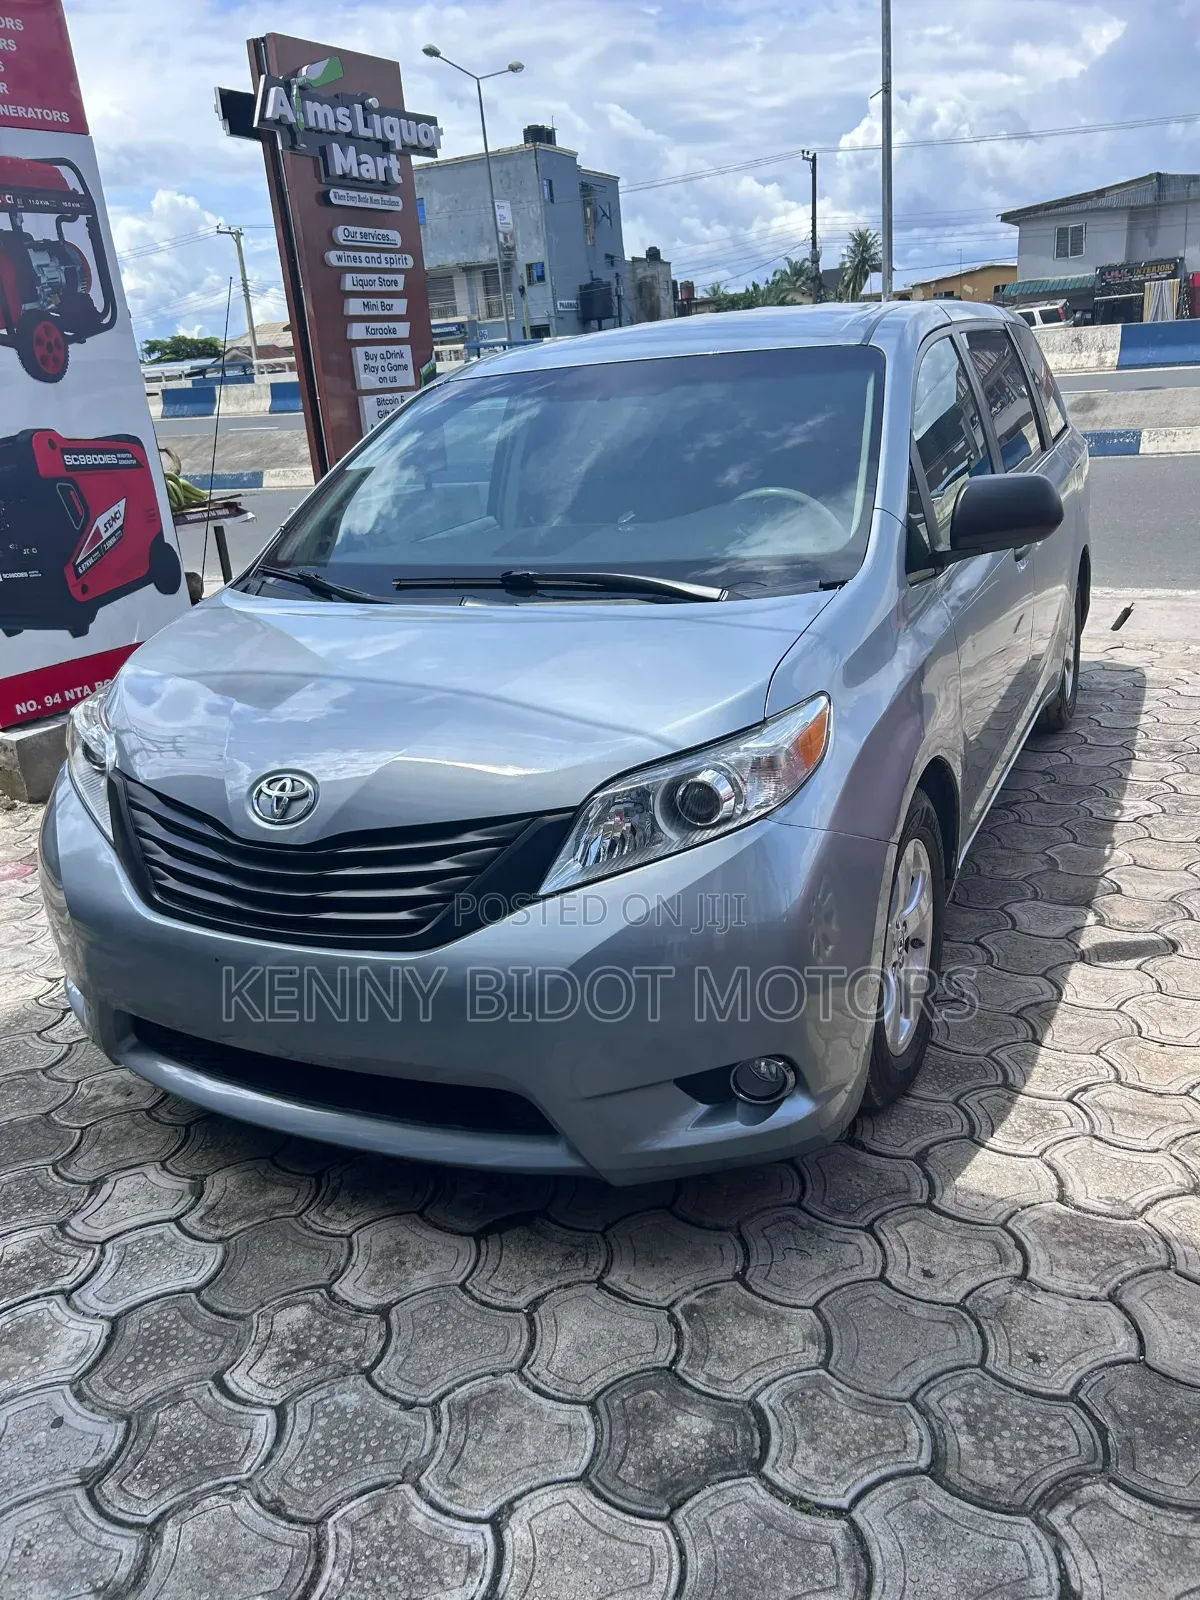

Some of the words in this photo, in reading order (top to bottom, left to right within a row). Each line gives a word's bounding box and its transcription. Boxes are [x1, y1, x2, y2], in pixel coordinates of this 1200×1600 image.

[326, 143, 403, 184] Mart
[343, 227, 358, 239] Our
[336, 252, 363, 264] wines
[364, 254, 382, 265] and
[384, 255, 408, 267] spirit
[1133, 263, 1175, 275] INTERIORS
[352, 276, 377, 289] Liquor
[378, 277, 399, 287] Store
[362, 301, 379, 312] Mini
[380, 301, 394, 312] Bar
[365, 325, 397, 335] Karaoke
[365, 351, 378, 362] Buy
[363, 364, 379, 374] Play
[387, 362, 409, 372] Game
[390, 375, 398, 383] us
[376, 396, 399, 406] Bitcoin
[377, 409, 390, 419] Gift
[104, 509, 122, 533] SENCI
[15, 700, 41, 715] NO.
[44, 693, 61, 707] 94
[64, 685, 92, 701] NTA
